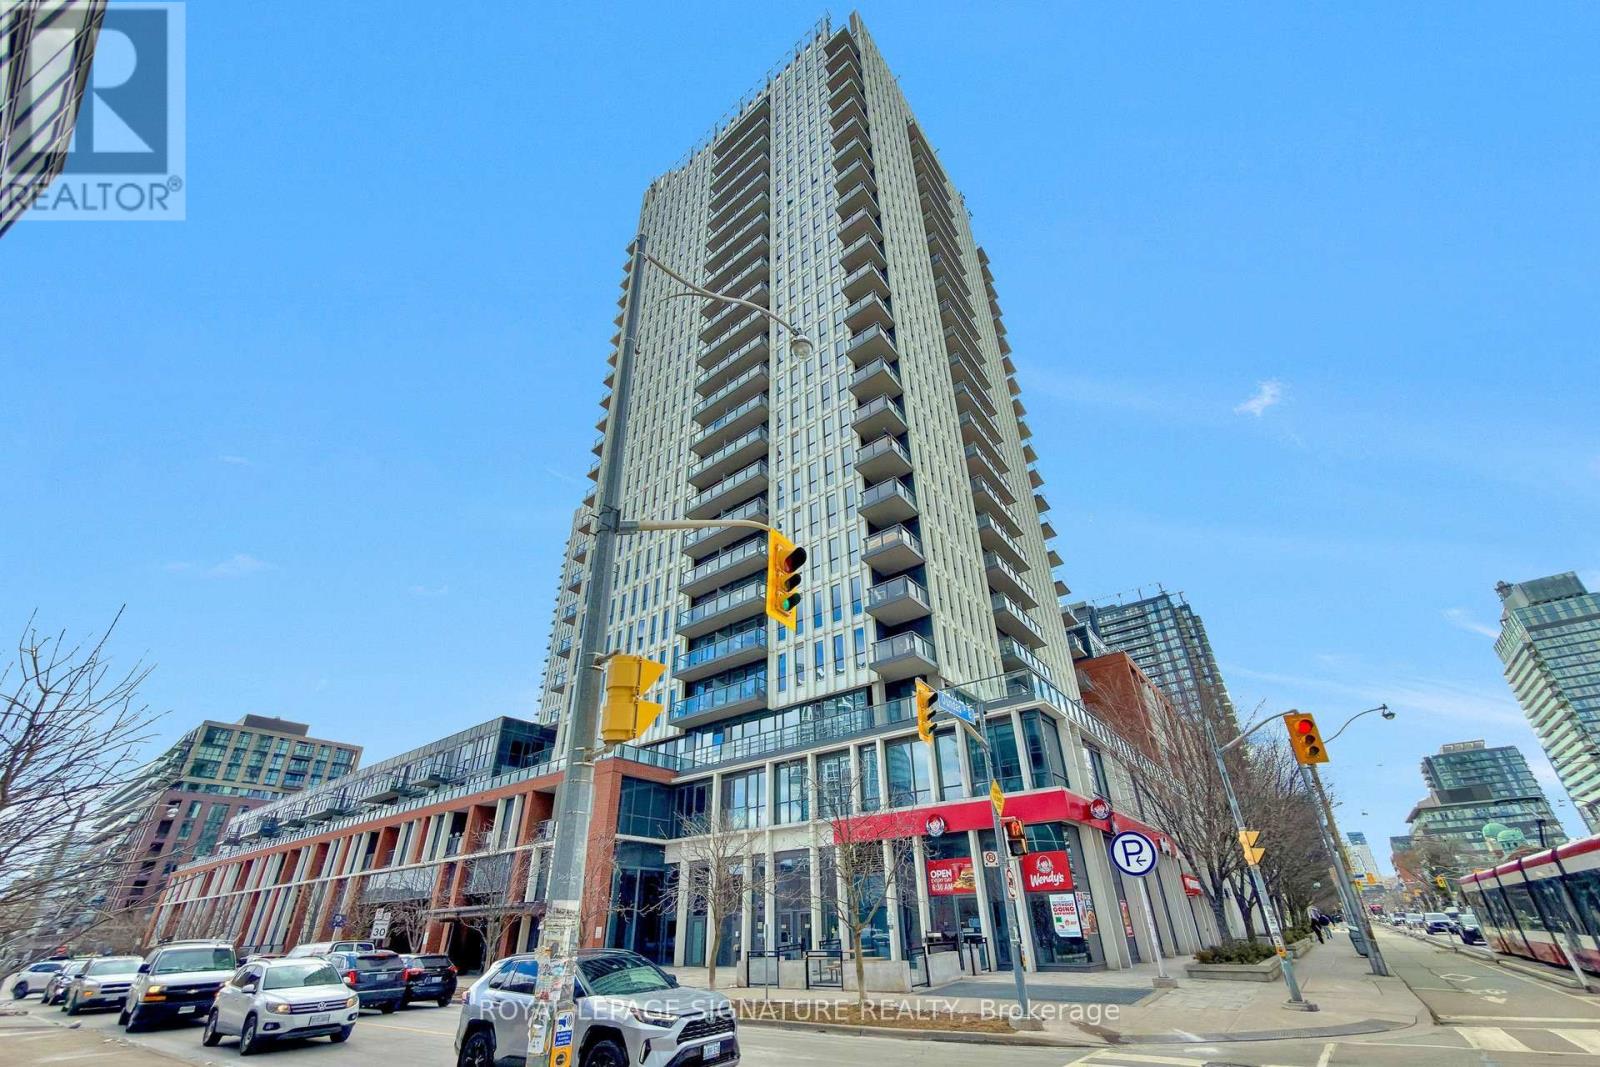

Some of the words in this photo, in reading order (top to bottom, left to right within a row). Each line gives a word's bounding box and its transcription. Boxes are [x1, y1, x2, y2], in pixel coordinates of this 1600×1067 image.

[930, 869, 952, 879] OPEN
[1030, 871, 1064, 887] Wendy's
[373, 928, 385, 936] 30
